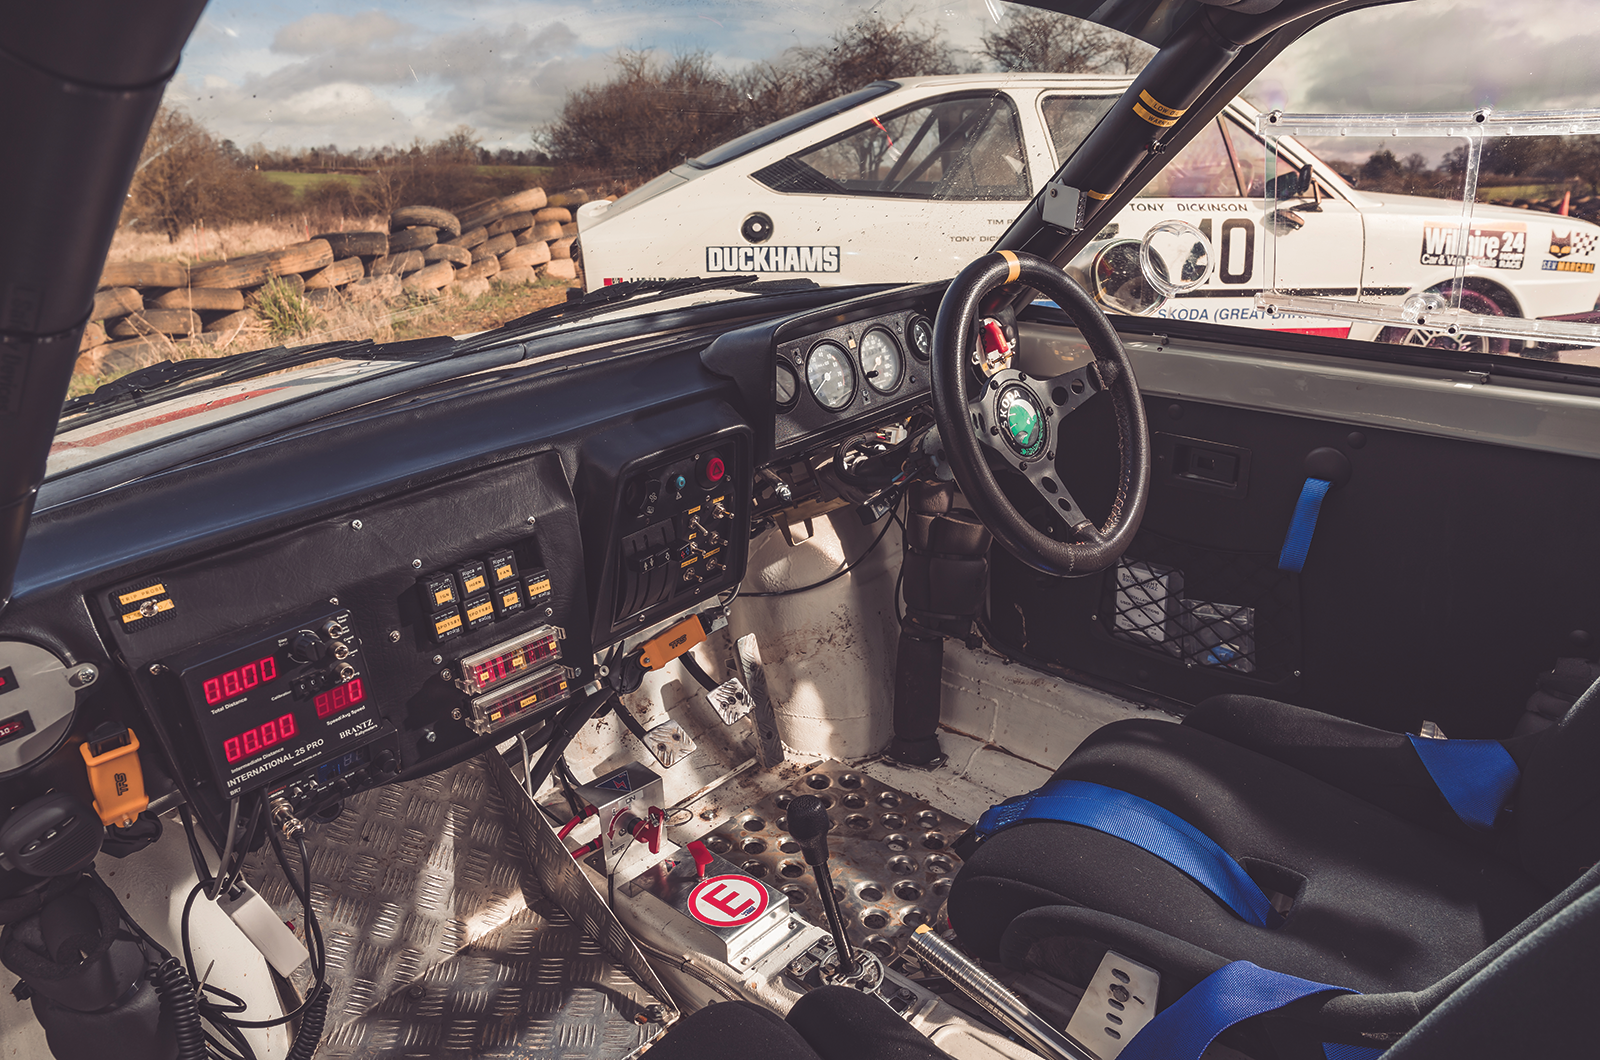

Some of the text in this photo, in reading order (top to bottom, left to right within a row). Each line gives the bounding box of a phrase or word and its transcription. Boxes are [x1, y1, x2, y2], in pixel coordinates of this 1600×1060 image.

[1129, 203, 1248, 212] TONY DICKINSON
[1501, 232, 1525, 253] 24
[708, 247, 839, 272] DUCKHAMS
[1422, 254, 1438, 264] Car
[1158, 308, 1209, 320] SKODA
[468, 580, 482, 588] HORN
[121, 586, 163, 604] TRIP PROBE
[668, 633, 688, 650] TRS
[210, 697, 248, 715] Total Distance
[339, 719, 374, 740] BRANTZ
[226, 738, 325, 788] INTERNATIONAL 2S PRO
[231, 747, 285, 774] Intermediate Distance
[114, 772, 129, 797] TRS
[625, 794, 637, 803] ON
[611, 843, 626, 856] OFF
[701, 883, 756, 918] E
